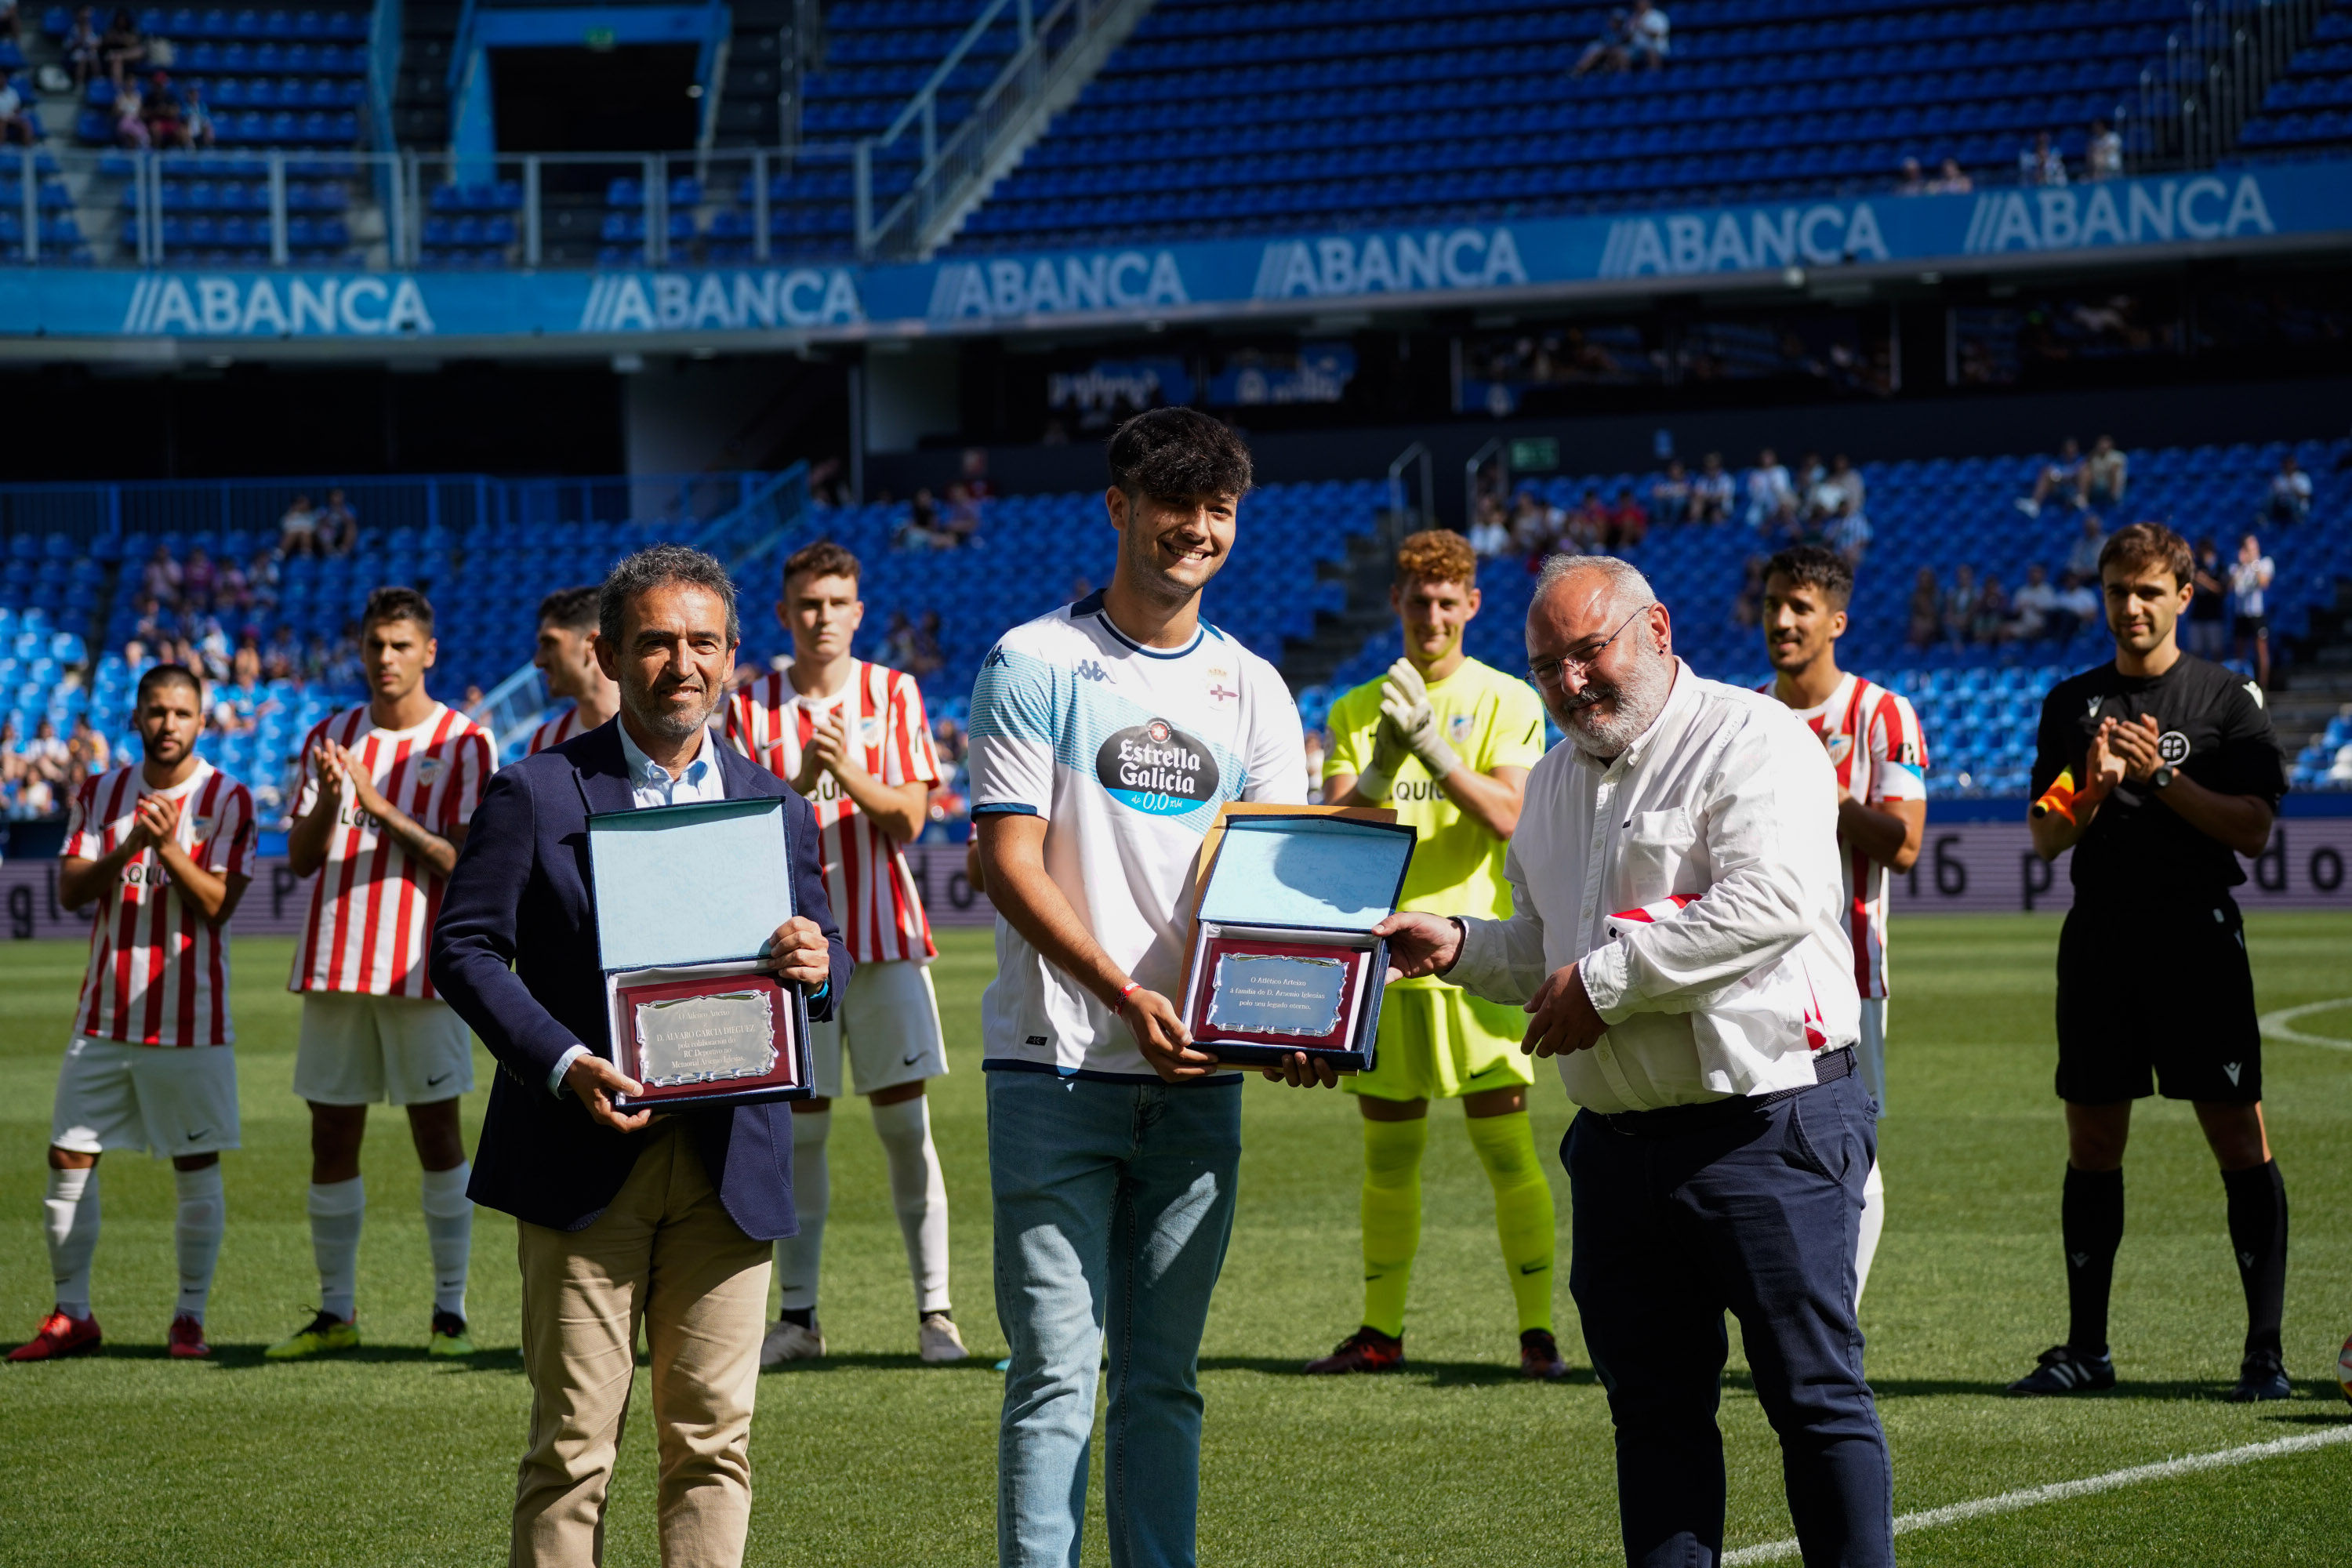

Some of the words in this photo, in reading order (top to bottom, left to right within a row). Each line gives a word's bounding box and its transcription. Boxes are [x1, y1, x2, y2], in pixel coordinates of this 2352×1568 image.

[1993, 174, 2277, 254] ABANCA
[1627, 201, 1889, 276] ABANCA
[956, 250, 1189, 318] ABANCA
[1279, 227, 1529, 298] ABANCA
[153, 277, 435, 333] ABANCA
[610, 269, 864, 330] ABANCA
[1117, 739, 1201, 771] Estrella
[1120, 761, 1196, 794] Galicia
[1267, 1000, 1288, 1009] legado
[1275, 989, 1300, 998] Arsenio
[1301, 991, 1326, 1000] Iglesias
[671, 1058, 699, 1069] Memorial
[683, 1049, 694, 1058] RC
[695, 1047, 723, 1057] Deportivo
